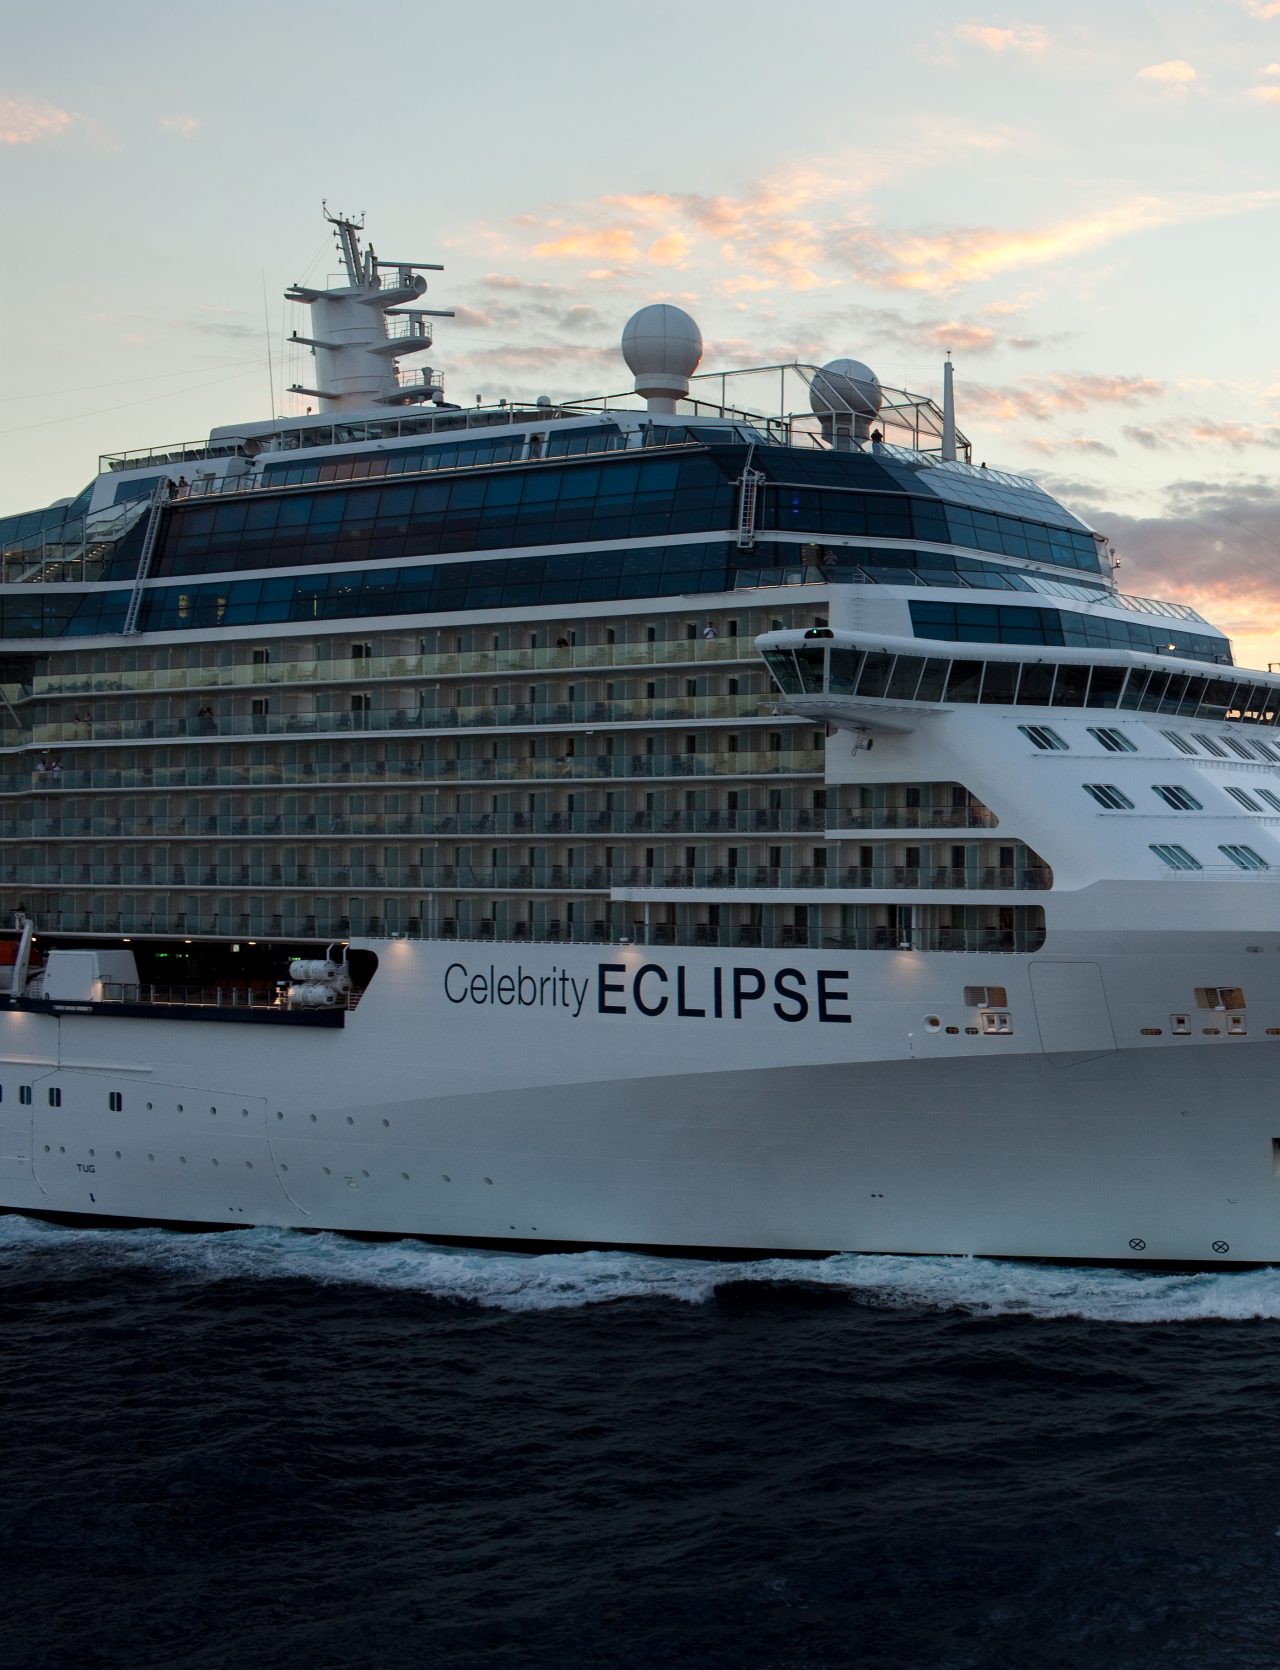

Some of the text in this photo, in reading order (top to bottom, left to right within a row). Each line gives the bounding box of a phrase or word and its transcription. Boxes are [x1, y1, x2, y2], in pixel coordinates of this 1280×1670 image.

[444, 963, 853, 1024] Celebrity ECLIPSE
[76, 1163, 96, 1173] TUG
